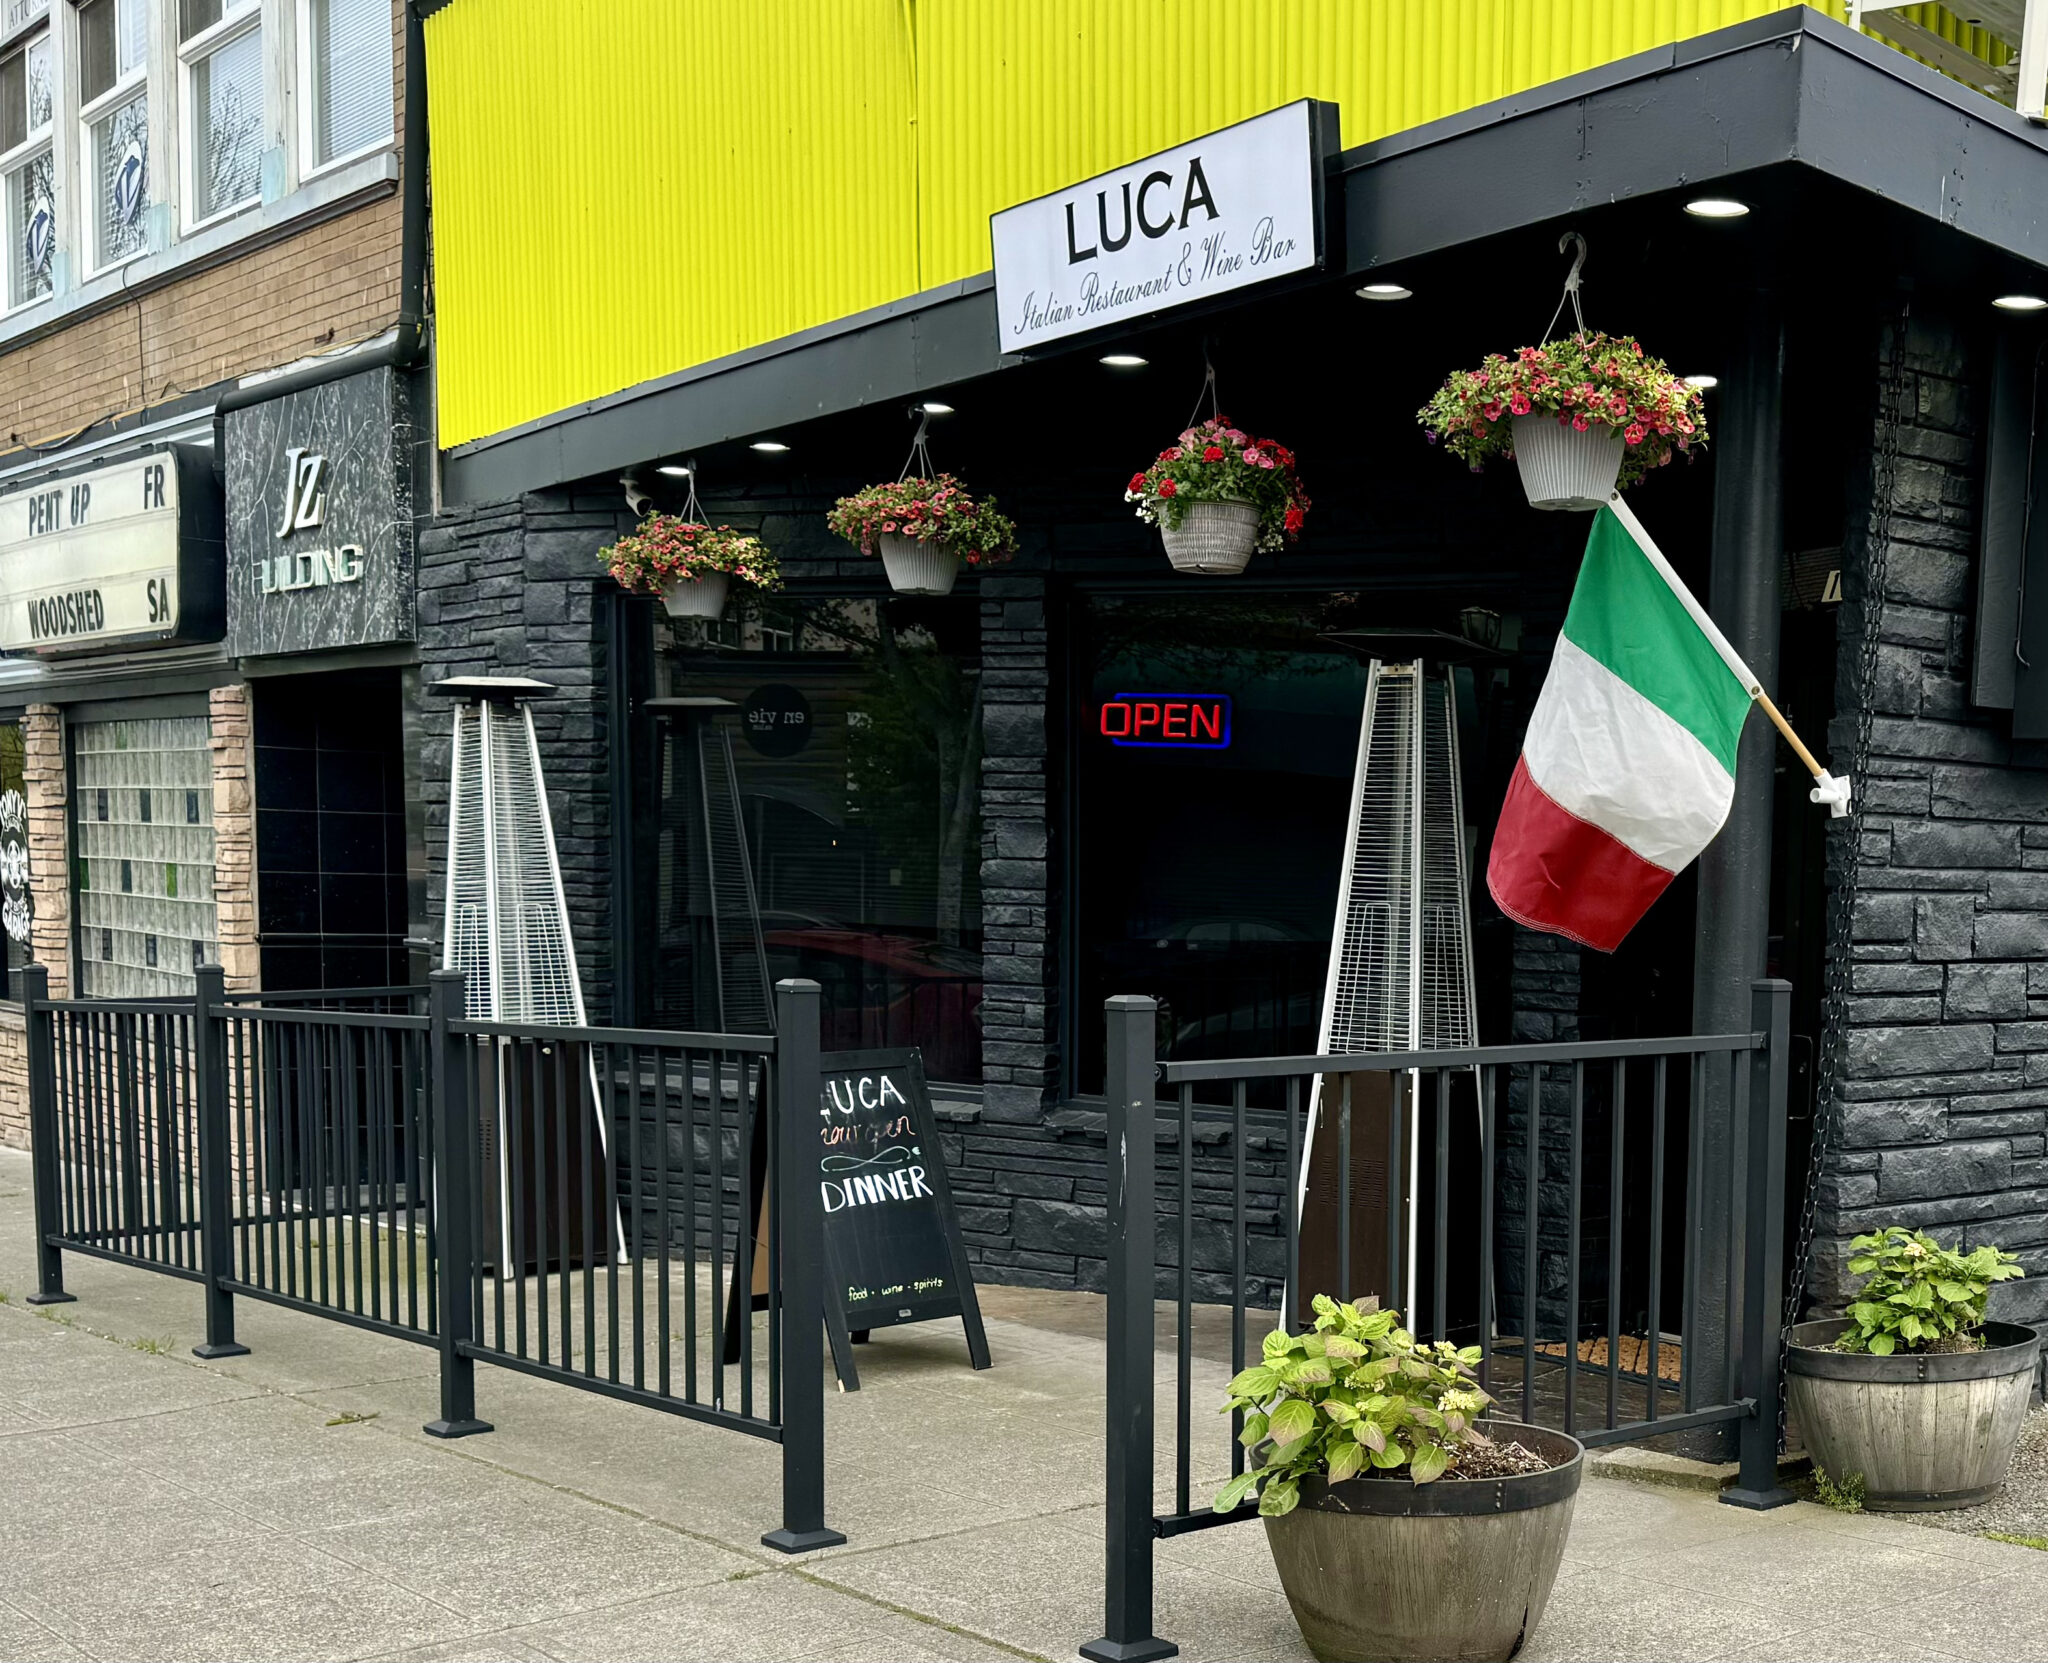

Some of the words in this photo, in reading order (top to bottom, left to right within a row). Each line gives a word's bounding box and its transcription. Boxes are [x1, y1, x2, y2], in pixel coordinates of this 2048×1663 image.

[1065, 156, 1220, 265] LUCA
[1014, 291, 1074, 334] Italian
[1077, 263, 1173, 317] Restaurant
[1177, 242, 1192, 287] &
[1201, 231, 1243, 282] Wine
[1250, 216, 1297, 266] Bar
[28, 489, 63, 537] PENT
[70, 483, 91, 526] UP
[143, 464, 165, 510] FR
[275, 447, 328, 538] JZ
[27, 589, 105, 640] WOODSHED
[147, 578, 171, 624] SA
[1100, 703, 1220, 739] OPEN
[820, 1165, 934, 1214] DINNER
[848, 1286, 868, 1302] food
[881, 1284, 904, 1297] wine
[913, 1278, 943, 1294] spirits
